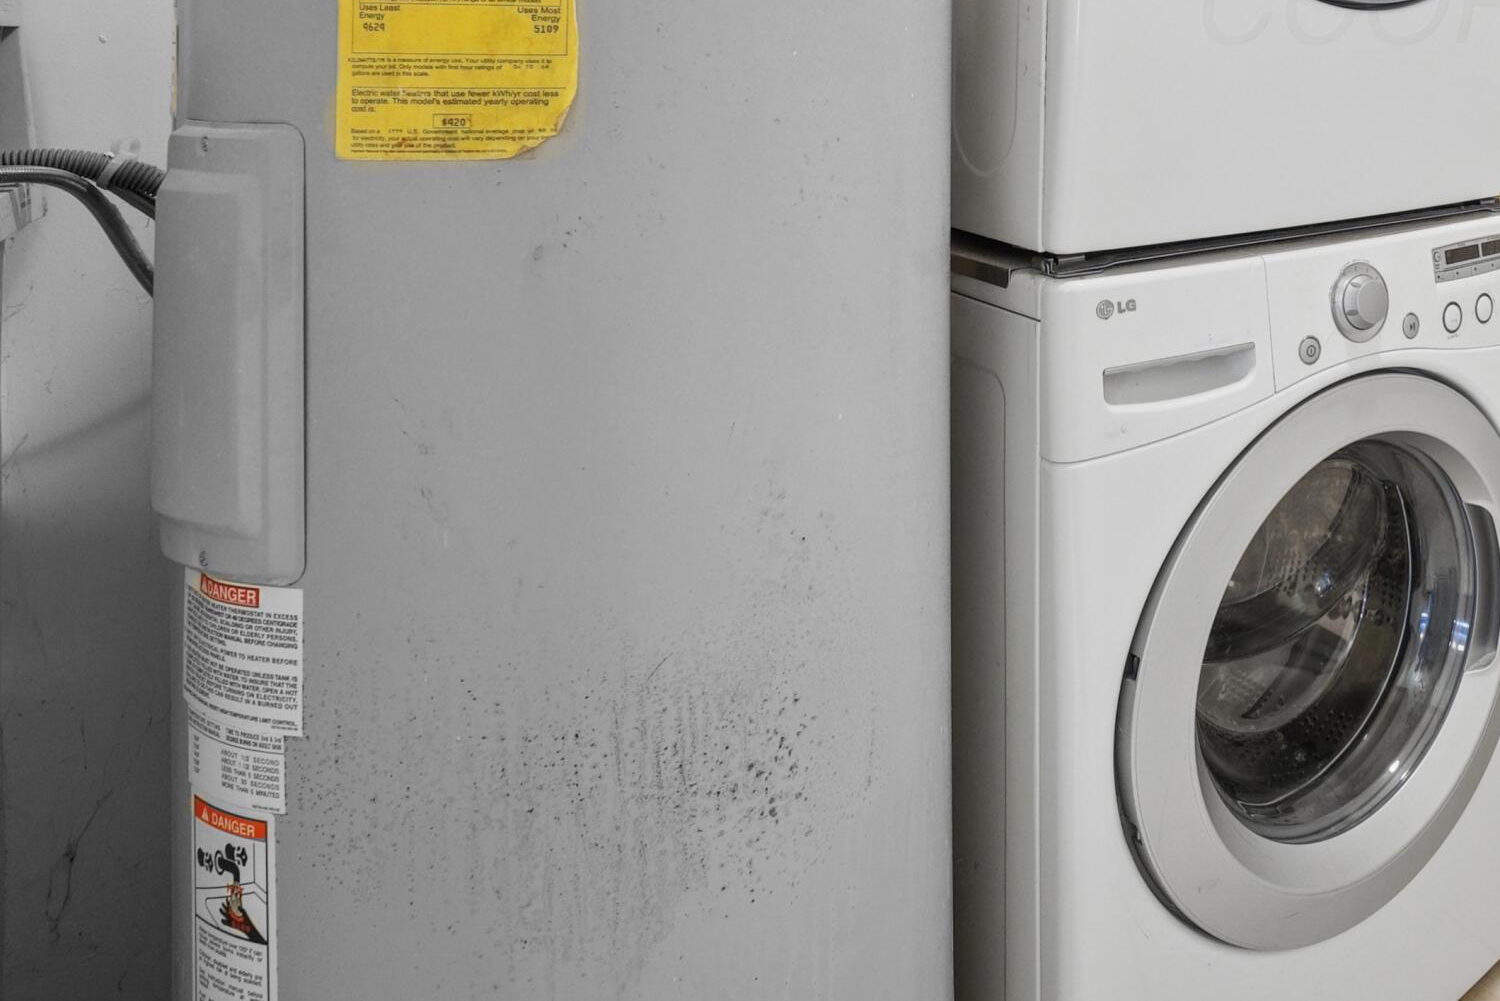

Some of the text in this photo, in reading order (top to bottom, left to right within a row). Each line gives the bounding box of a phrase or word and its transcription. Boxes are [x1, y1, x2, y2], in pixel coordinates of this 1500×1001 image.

[360, 12, 384, 20] Energy
[531, 14, 560, 23] Energy
[534, 24, 560, 34] 5109
[492, 90, 521, 98] kWh/yr
[442, 118, 466, 126] $420
[208, 580, 257, 604] DANGER
[228, 606, 264, 617] THERMOSTAT
[220, 619, 244, 629] SCALDING
[254, 624, 274, 632] OTHER
[275, 627, 298, 636] INJURY,
[262, 618, 298, 628] CENTIGRADE
[240, 630, 264, 638] ELDERLY
[266, 634, 297, 642] PERSONS.
[244, 638, 298, 650] BEFORE CHANGING
[220, 648, 238, 656] POWER
[247, 654, 270, 663] HEATER
[272, 658, 298, 666] BEFORE
[225, 666, 250, 676] OPERATED
[252, 671, 274, 679] UNLESS
[248, 678, 269, 686] INSURE
[222, 686, 244, 696] TURNING
[256, 693, 297, 702] ELECTRICITY.
[224, 693, 243, 702] RESULT
[258, 701, 282, 710] BURNED
[221, 748, 280, 766] ABOUT SECOND
[221, 757, 280, 774] ABOUT SECONDS
[233, 768, 246, 777] THAN
[254, 773, 280, 782] SECONDS
[222, 774, 280, 790] ABOUT SECONDS
[222, 782, 280, 798] MORE THAN MINUTES
[212, 813, 256, 837] DANGER
